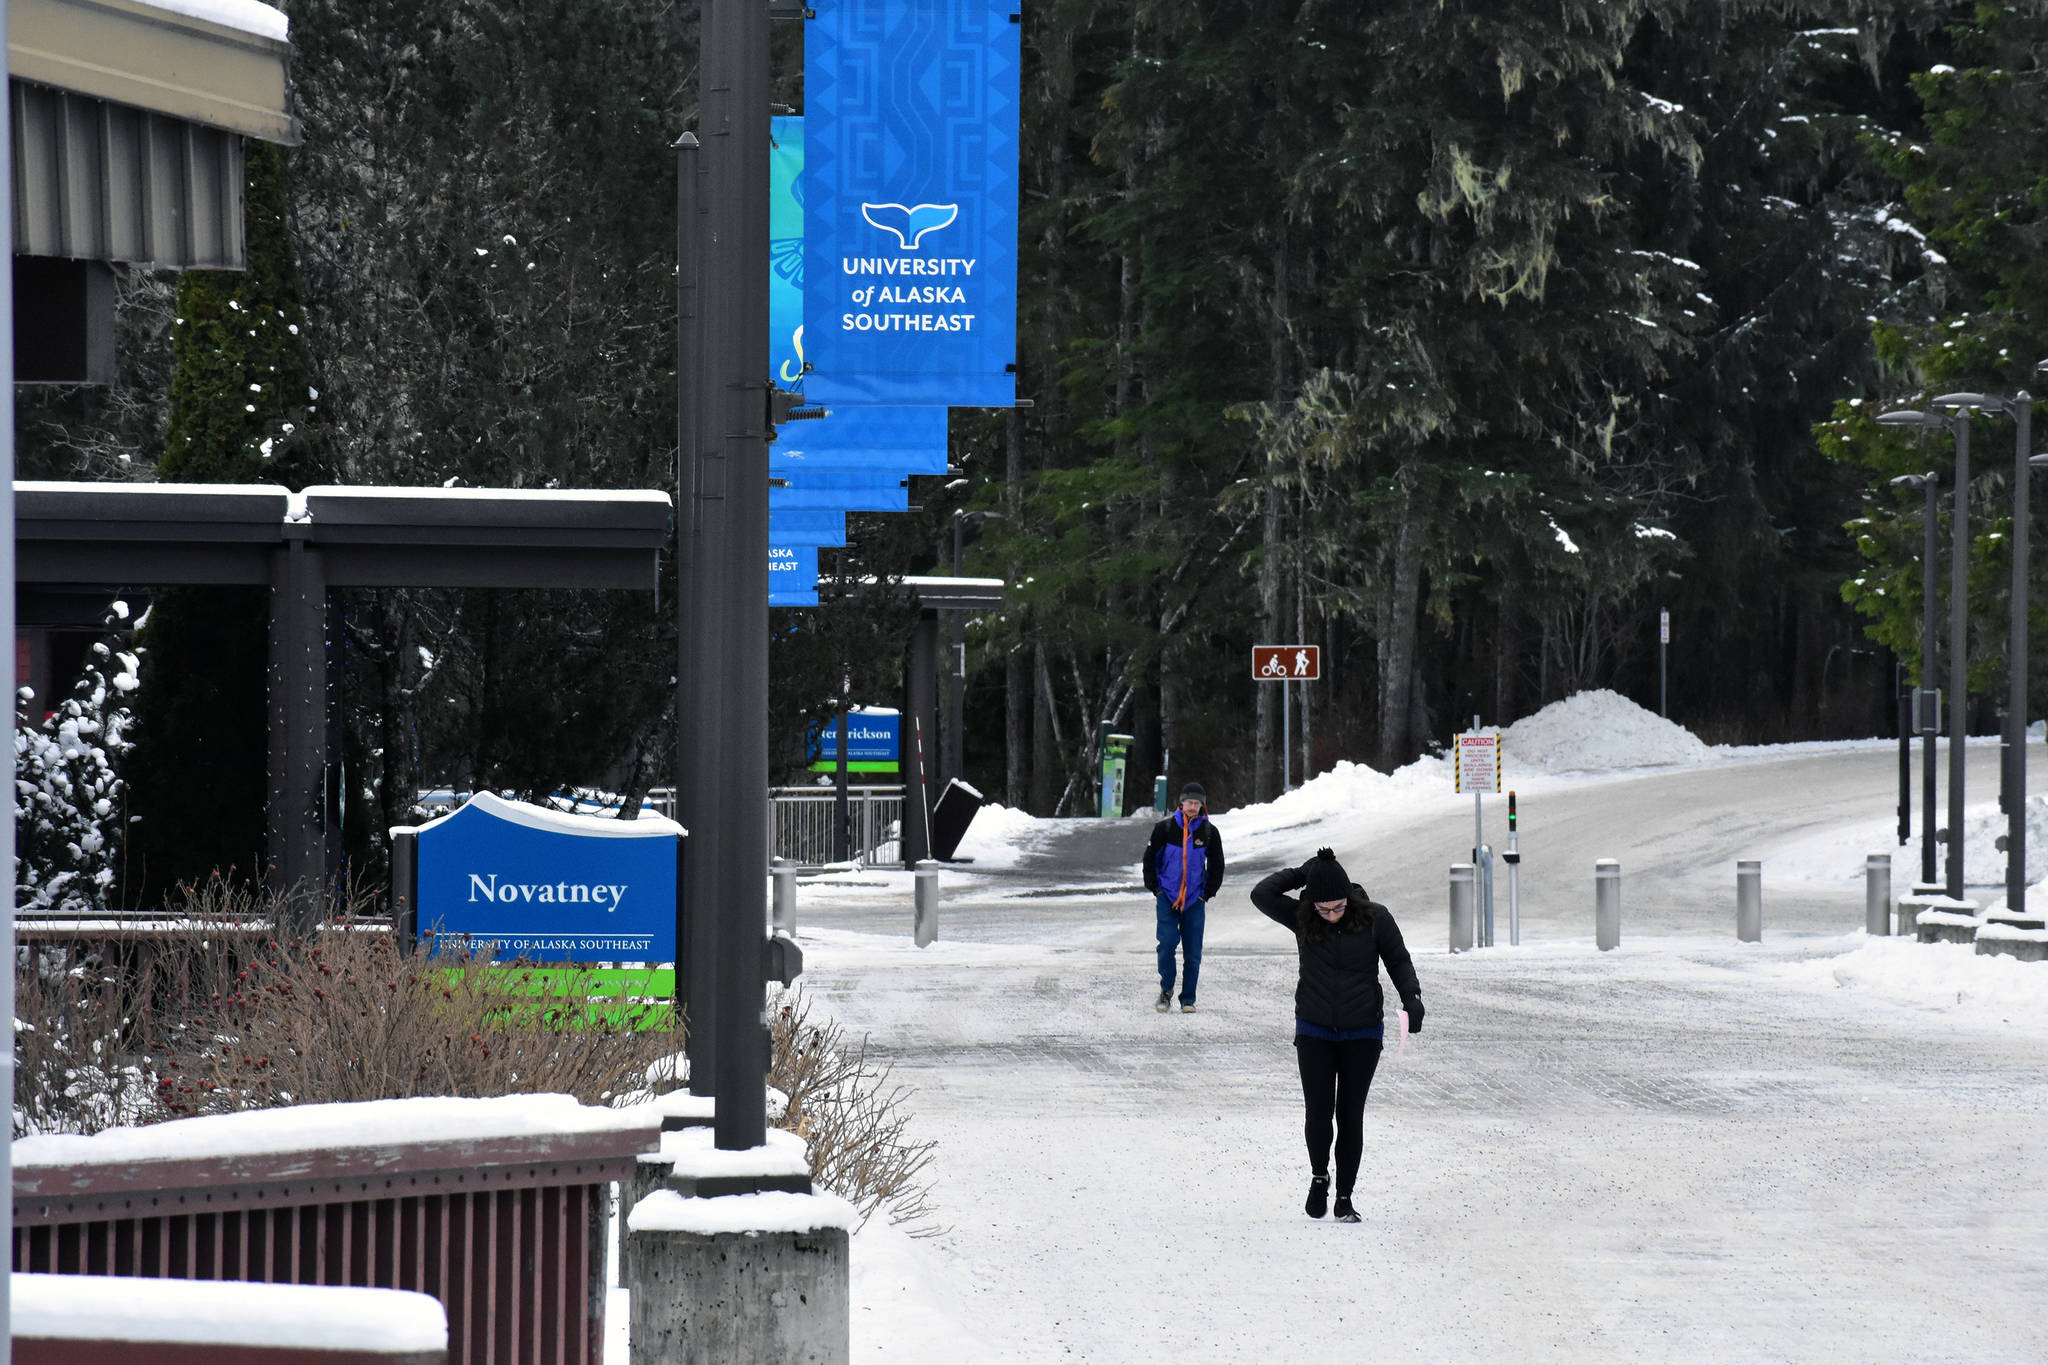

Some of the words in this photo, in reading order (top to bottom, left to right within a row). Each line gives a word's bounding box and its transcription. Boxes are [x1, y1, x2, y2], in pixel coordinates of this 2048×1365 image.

[842, 258, 976, 275] UNIVERSITY
[851, 286, 875, 308] of
[878, 286, 966, 303] ALASKA
[842, 314, 976, 332] SOUTHEAST
[468, 873, 628, 912] Novatney
[513, 939, 530, 950] OF
[533, 939, 577, 950] ALASKA
[579, 939, 651, 950] SOUTHEAST
